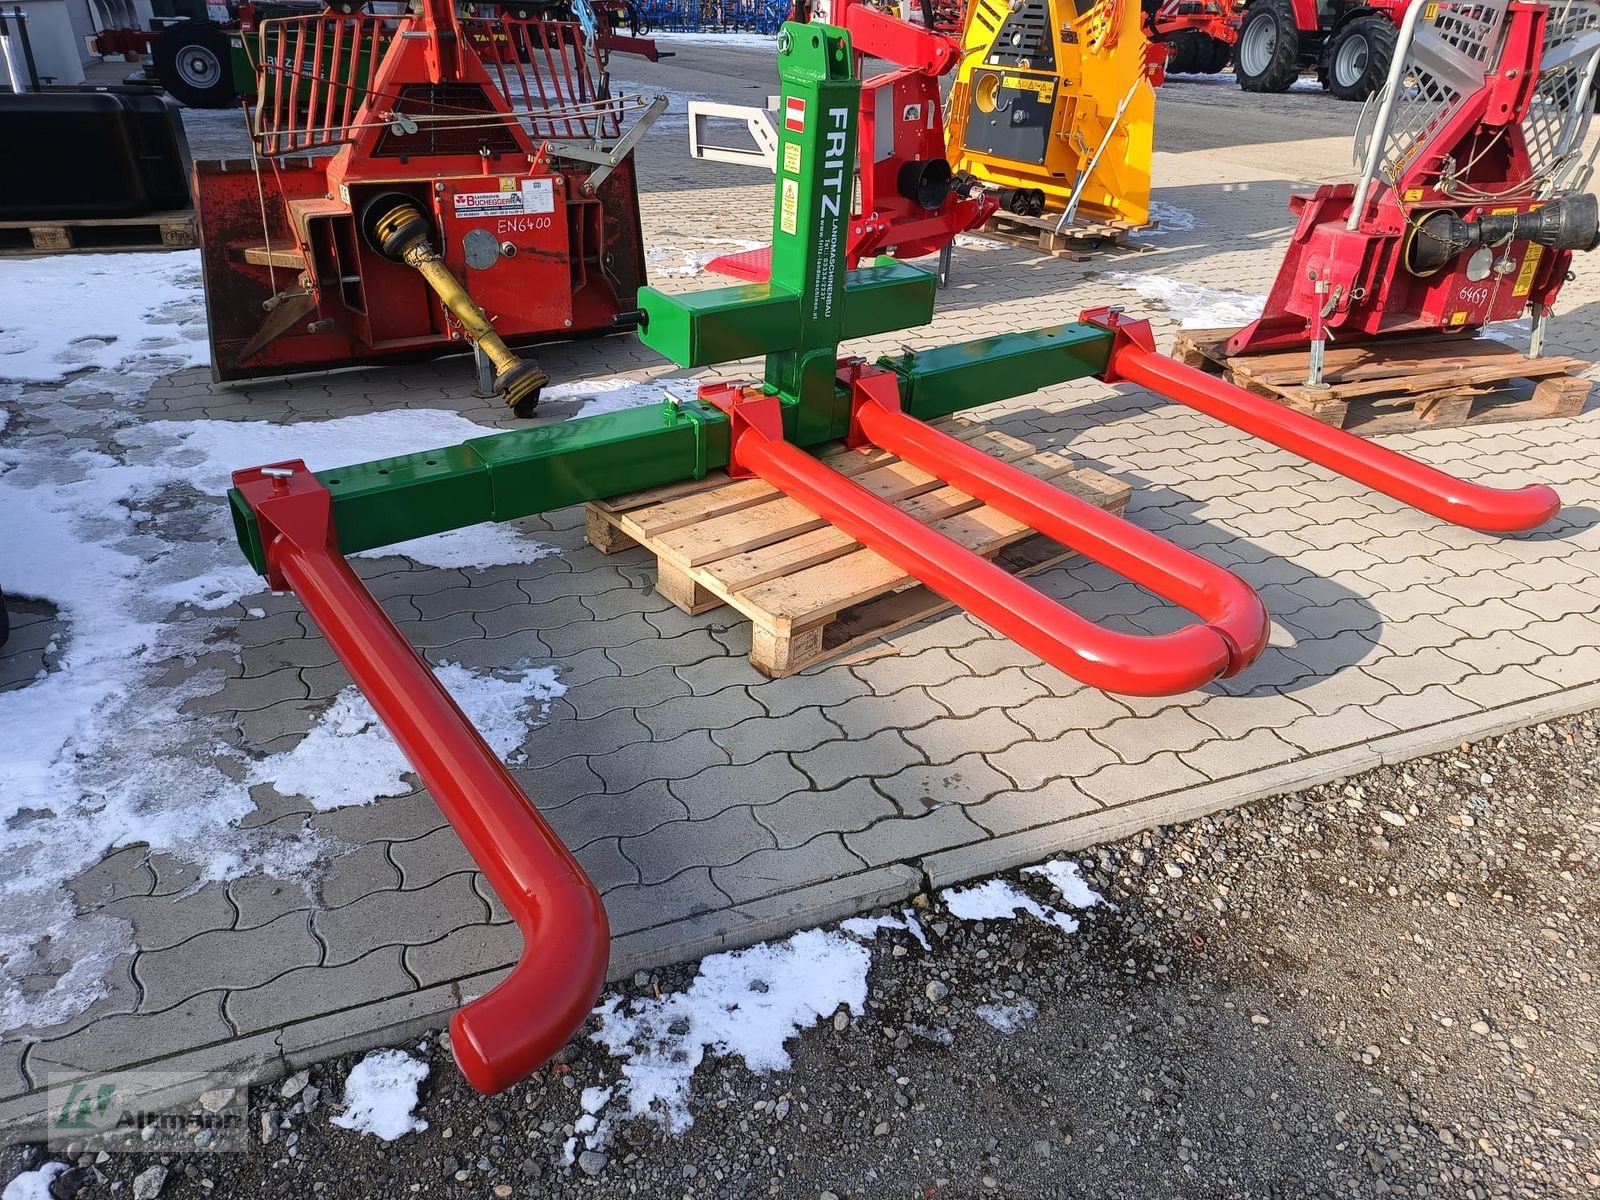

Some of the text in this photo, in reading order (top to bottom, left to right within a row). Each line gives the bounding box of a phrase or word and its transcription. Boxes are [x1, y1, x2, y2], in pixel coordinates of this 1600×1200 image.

[821, 107, 848, 219] FRITZ
[497, 217, 551, 233] EN6400
[823, 239, 831, 256] Tel.:
[812, 219, 825, 320] www.fritz-landmaschinen.at
[824, 218, 839, 318] LANDMASCHINENBAU
[1459, 286, 1488, 308] 6469
